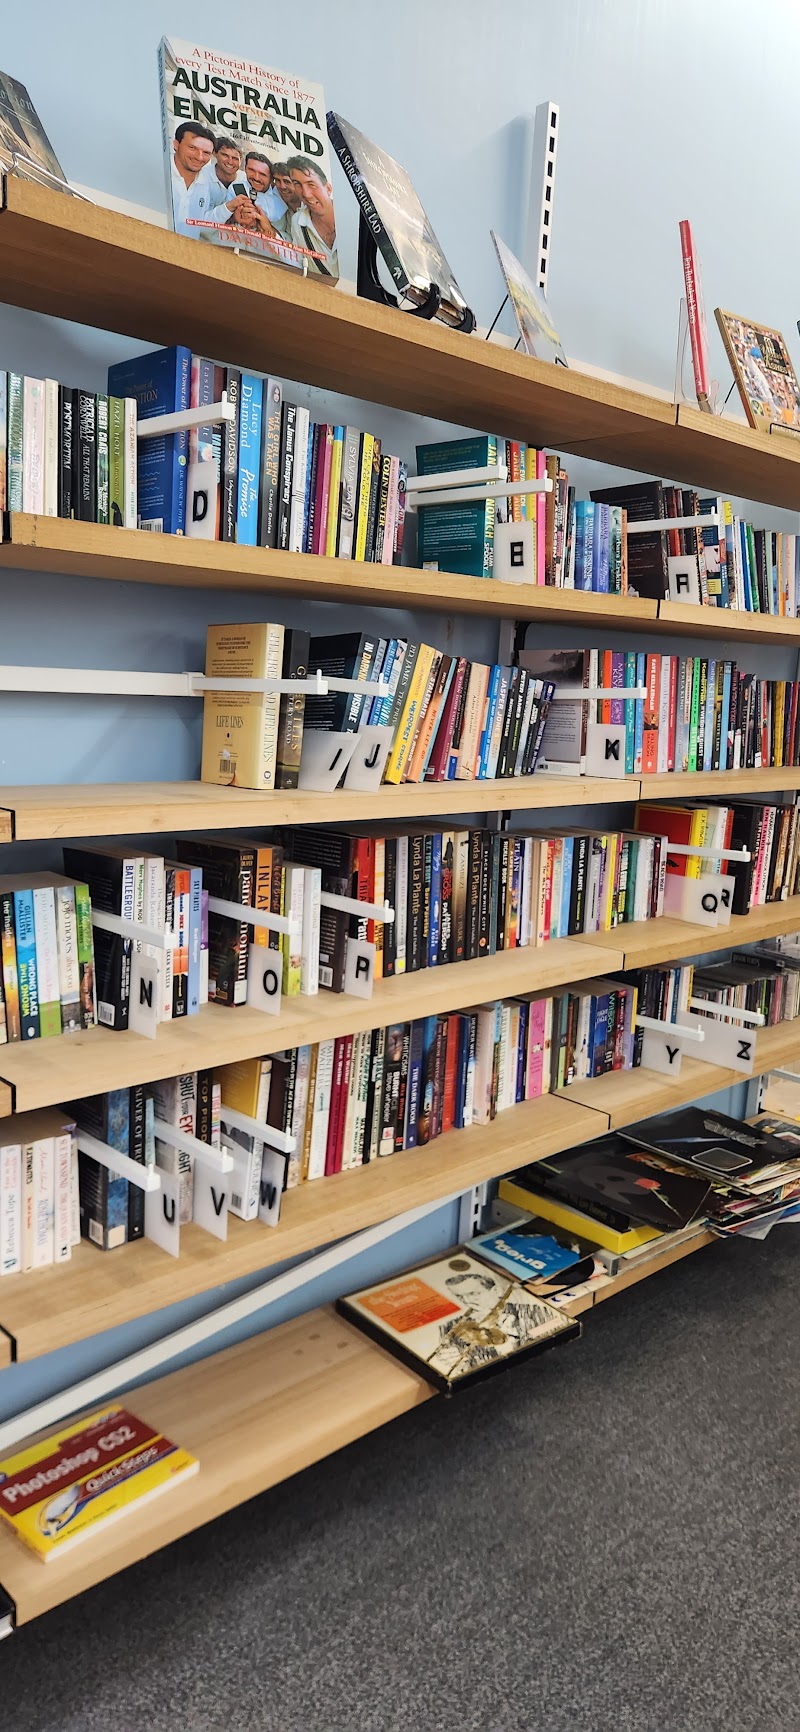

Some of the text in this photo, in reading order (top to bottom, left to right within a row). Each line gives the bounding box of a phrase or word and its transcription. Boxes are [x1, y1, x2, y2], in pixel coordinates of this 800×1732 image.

[175, 56, 316, 105] every Test Match since 1877
[192, 48, 300, 88] A Pictorial History of
[172, 67, 322, 131] AUSTRALIA
[231, 101, 270, 119] versus
[173, 95, 324, 157] ENGLAND
[338, 147, 381, 234] A SHROPSHIRE LAD
[218, 231, 259, 249] DAVID
[80, 395, 88, 440] CORNWELL
[86, 397, 95, 434] PATRICIA
[98, 400, 108, 455] ROBERT CRAIS
[241, 385, 253, 448] Diamond
[251, 403, 260, 436] Lucy
[63, 401, 72, 470] POSTMORTEM
[266, 442, 274, 475] TAKEN
[282, 408, 296, 504] The Janus Conspiracy
[240, 468, 255, 518] Promise
[346, 446, 356, 506] SYLVIA DAY
[379, 457, 390, 526] COLIN DEXTER
[193, 490, 208, 522] D
[510, 541, 525, 567] E
[348, 642, 374, 723] IN VISIBLE
[396, 658, 412, 706] JAMES THE
[519, 670, 527, 694] PETER
[216, 715, 244, 728] LIFE LINES
[402, 699, 418, 743] WEIRDEST
[494, 678, 507, 738] JASPER JONES
[263, 707, 276, 763] LIFE LINES
[291, 717, 299, 750] ILES
[420, 709, 437, 760] NEVER LET GO
[605, 739, 620, 761] K
[329, 748, 342, 771] I
[364, 743, 381, 768] J
[411, 837, 422, 915] Lynda La Plante
[471, 831, 480, 905] Lynda La Plante
[578, 860, 585, 868] LA
[619, 871, 627, 890] EVENT
[18, 899, 26, 941] McALLISTER
[701, 893, 718, 913] Q
[61, 900, 73, 954] jojo moyes
[422, 906, 430, 938] Paretsky
[263, 969, 279, 996] O
[355, 955, 370, 979] P
[21, 984, 29, 1017] WRONG
[28, 958, 38, 1016] WRONG PLACE
[140, 977, 152, 1007] N
[607, 993, 616, 1033] Wilson
[317, 1046, 326, 1090] WALTERS
[400, 1036, 409, 1075] WHITICISMS
[666, 1044, 679, 1064] Y
[736, 1040, 751, 1061] Z
[383, 1072, 393, 1123] steve wheeler
[392, 1071, 400, 1097] BURNT
[410, 1083, 418, 1102] DARK
[134, 1125, 142, 1138] OF
[179, 1115, 194, 1134] EYE
[409, 1103, 417, 1124] ROOM
[59, 1152, 68, 1188] TOWNSEND
[163, 1193, 175, 1222] U
[210, 1186, 225, 1216] V
[260, 1180, 276, 1210] W
[2, 1447, 100, 1503] Photoshop
[98, 1425, 137, 1451] CS2
